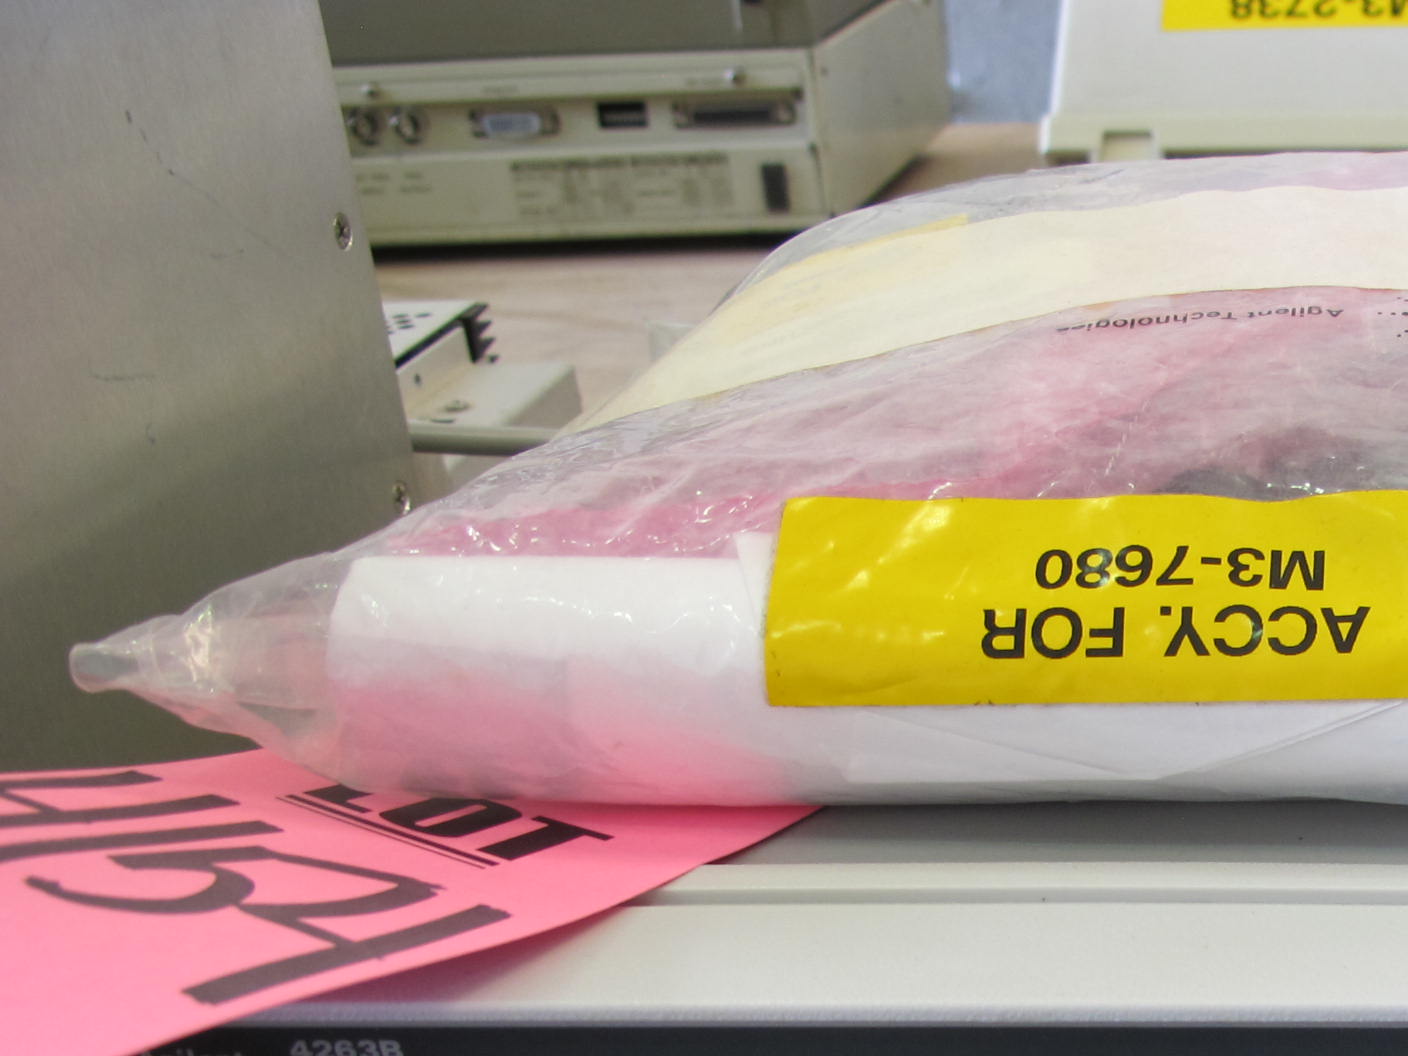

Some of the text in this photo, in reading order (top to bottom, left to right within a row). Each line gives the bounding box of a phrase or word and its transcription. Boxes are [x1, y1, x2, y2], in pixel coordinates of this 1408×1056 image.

[1248, 305, 1344, 319] Agilent
[1035, 544, 1326, 591] M3-7680
[981, 605, 1371, 660] ACCY. FOR
